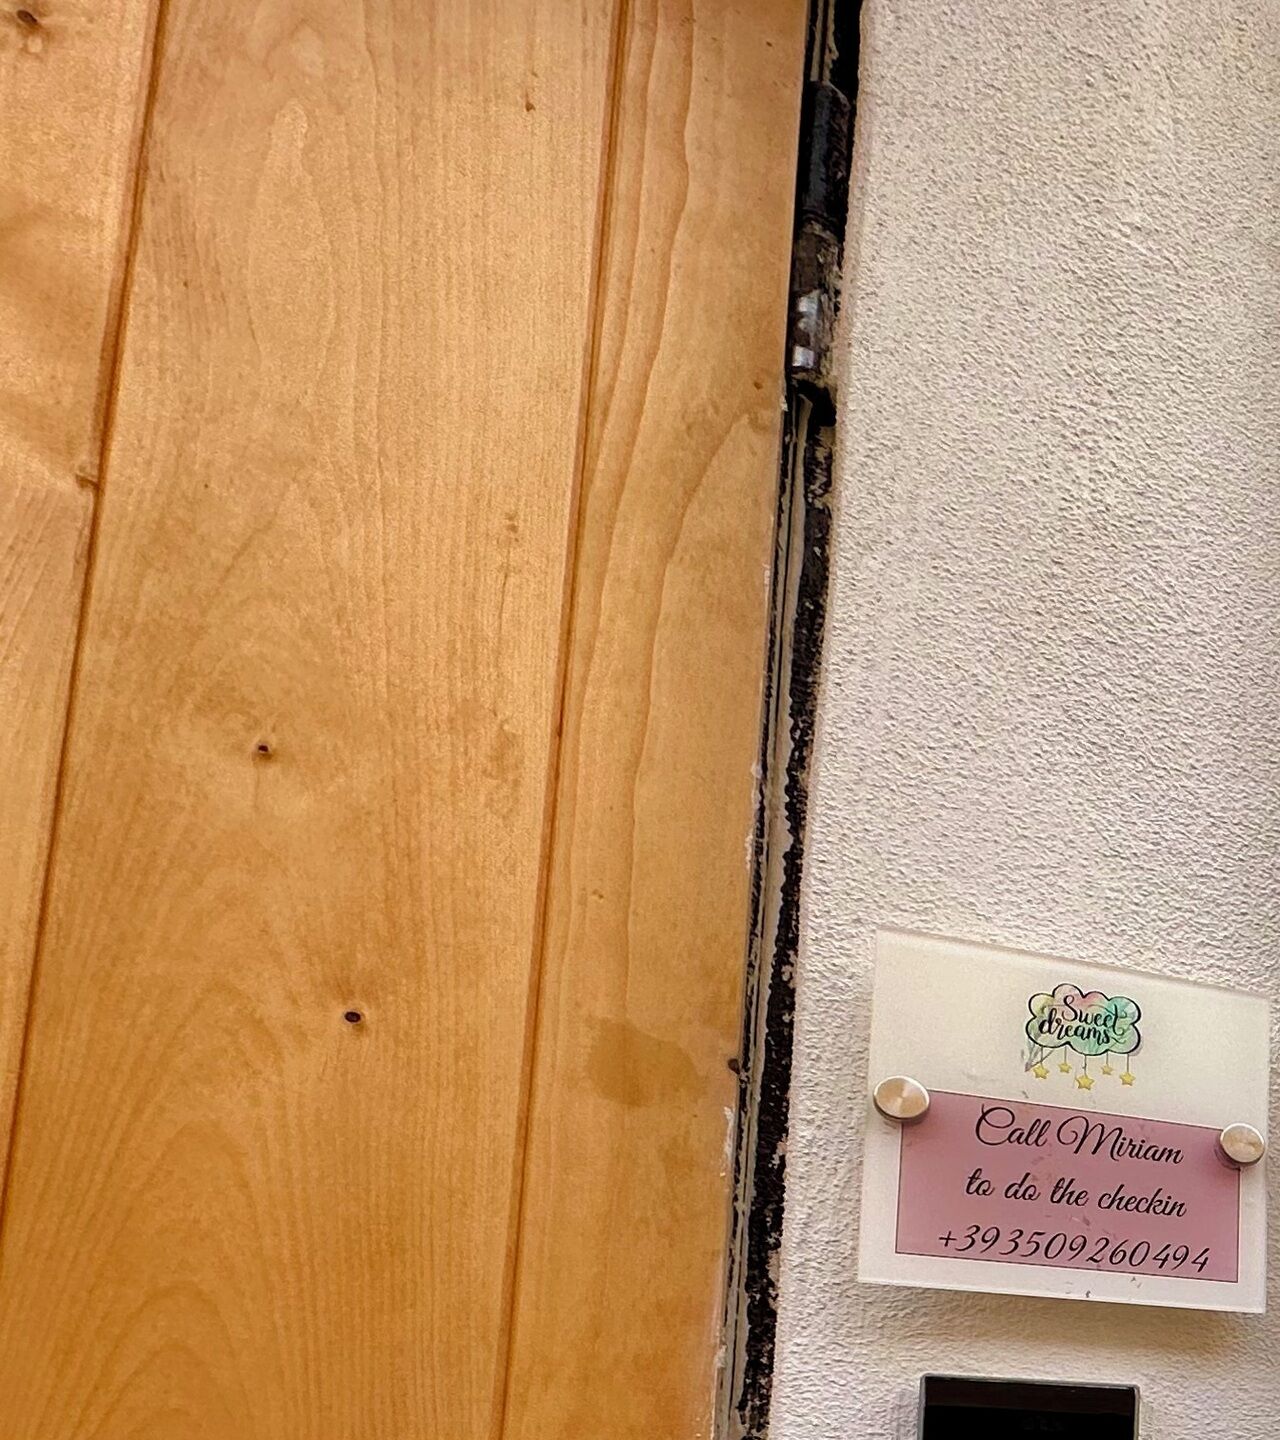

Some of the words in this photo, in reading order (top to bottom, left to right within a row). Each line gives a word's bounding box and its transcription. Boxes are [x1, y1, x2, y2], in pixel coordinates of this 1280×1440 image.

[1038, 1007, 1126, 1046] dreams
[1042, 994, 1127, 1036] Sweet
[975, 1104, 1048, 1149] Call
[1057, 1115, 1184, 1164] Miriam
[965, 1168, 994, 1197] to
[1004, 1172, 1041, 1201] do
[1050, 1177, 1089, 1207] the
[1098, 1185, 1187, 1217] checkin
[938, 1223, 1210, 1273] +393509260494
